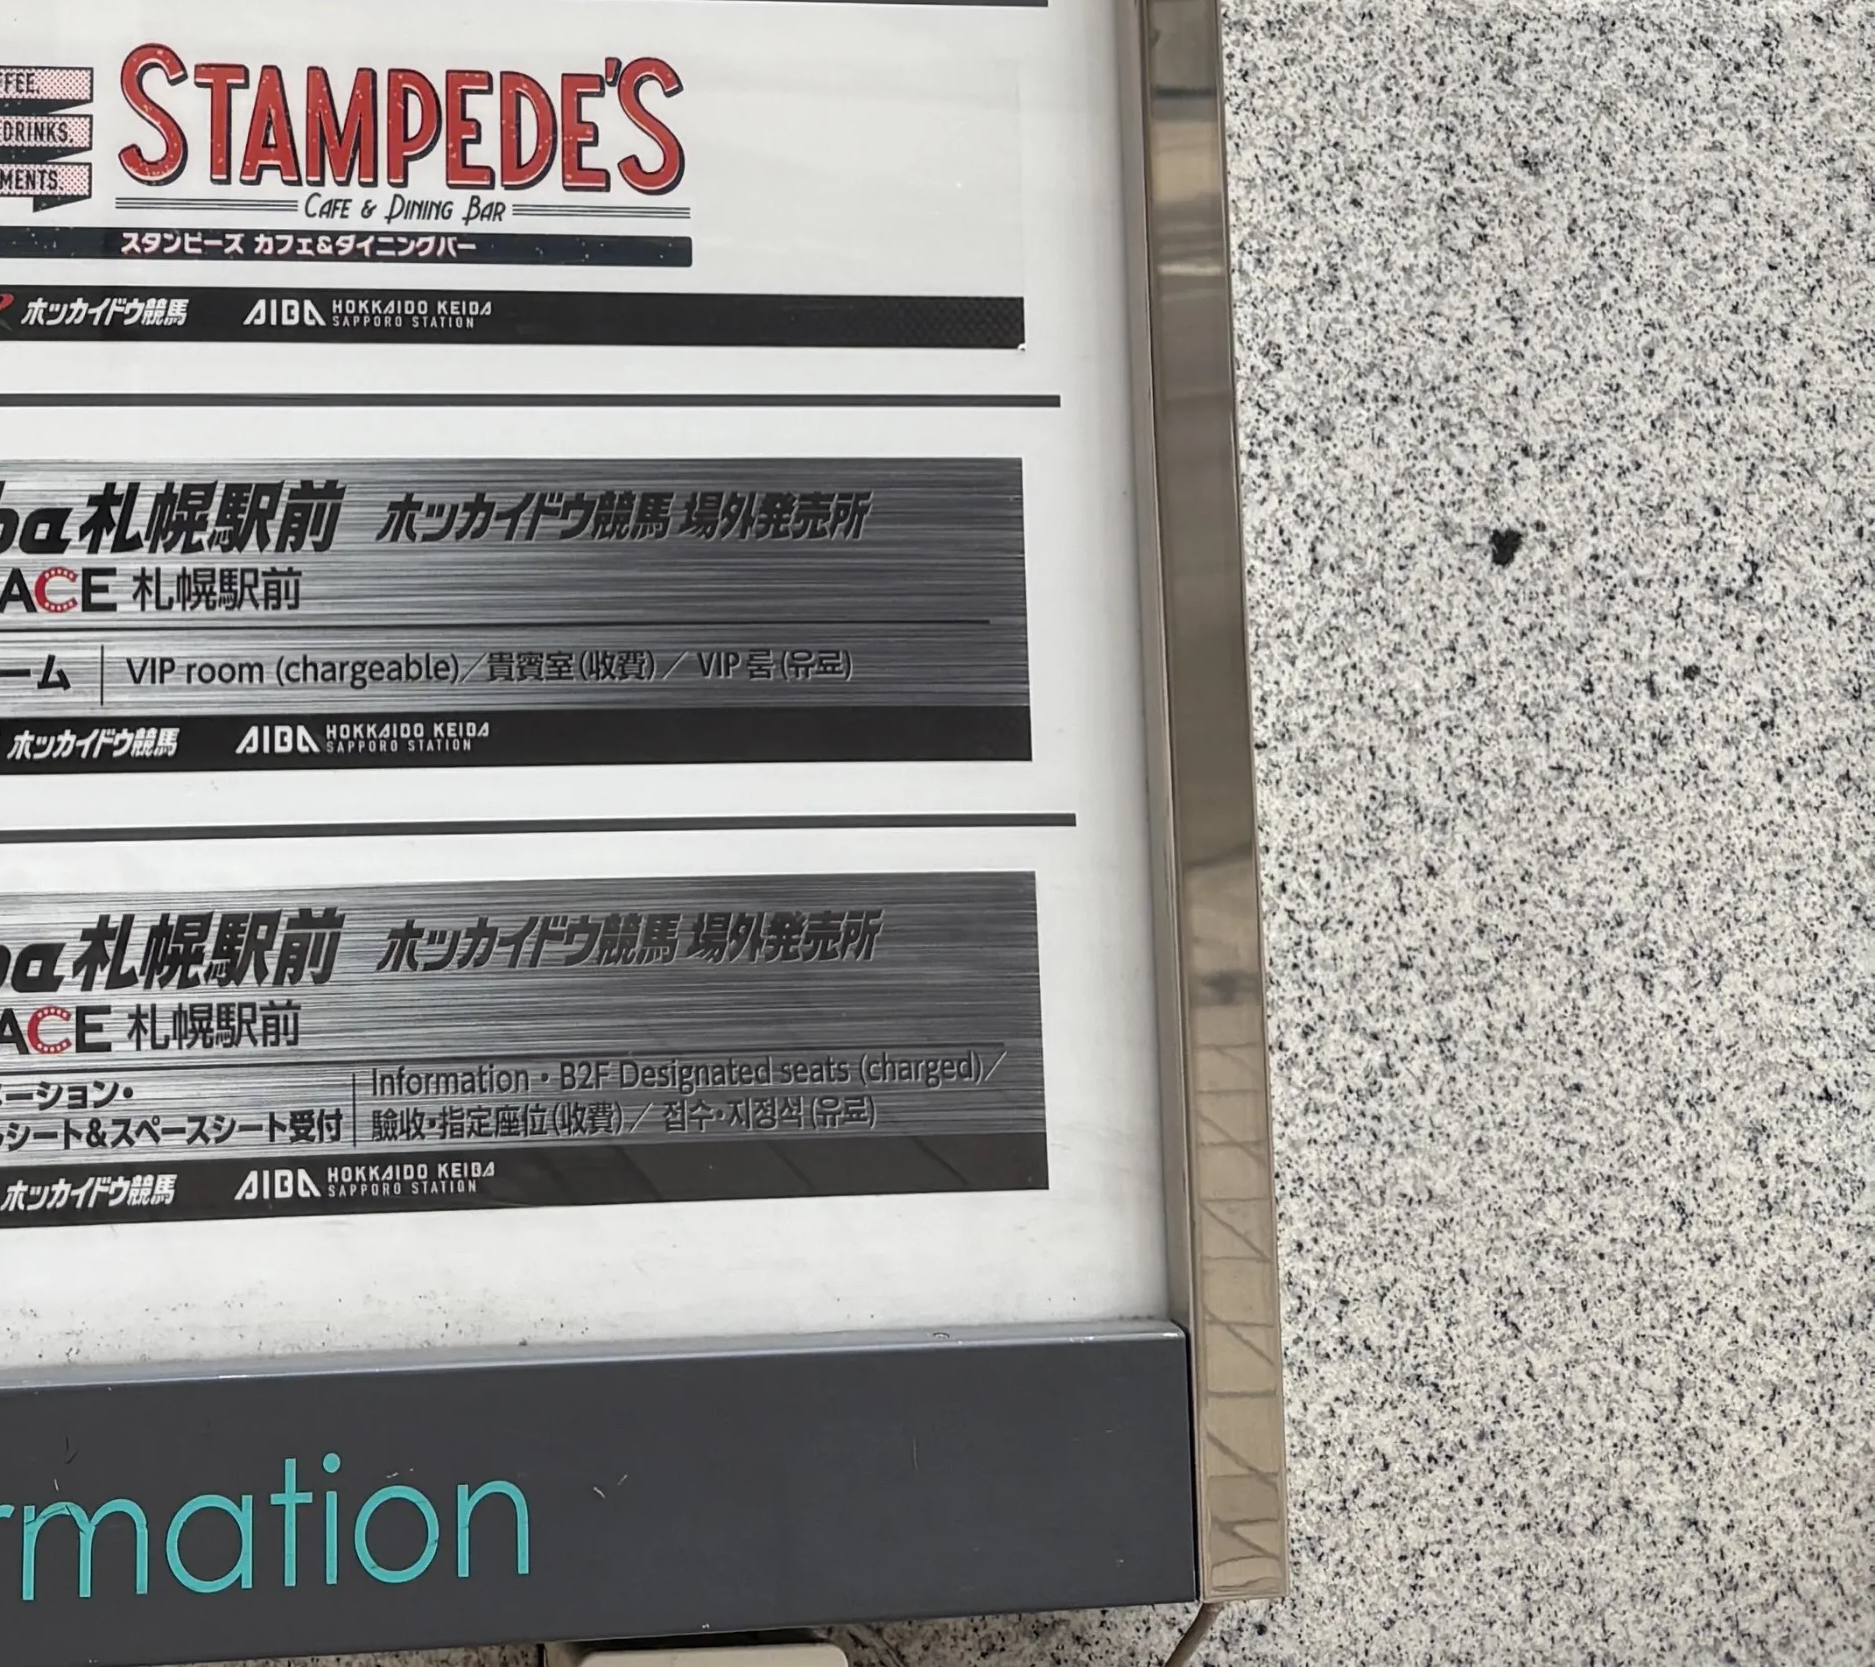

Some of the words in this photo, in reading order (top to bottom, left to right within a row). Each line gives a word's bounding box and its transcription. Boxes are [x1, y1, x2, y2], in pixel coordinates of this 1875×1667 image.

[117, 42, 685, 196] STAMPEDE'S
[360, 198, 378, 219] &
[20, 296, 190, 327] ホッカイドウ競馬
[332, 299, 428, 315] HOKKAIDO
[332, 315, 403, 328] SAPPORO
[412, 316, 475, 329] STATION
[131, 566, 303, 612] 札幌駅前
[125, 656, 176, 685] VIP
[185, 660, 264, 685] room
[697, 651, 741, 680] VIP
[6, 727, 181, 760] ホッカイドウ競馬
[326, 721, 425, 740] HOKKAIDO
[326, 739, 400, 754] SAPPORO
[407, 738, 472, 752] STATION
[126, 999, 302, 1052] 札幌駅前
[618, 1055, 774, 1097] Designated
[779, 1061, 851, 1087] seats
[327, 1162, 429, 1183] HOKKAIDO
[0, 1173, 178, 1213] ホッカイドウ競馬
[327, 1181, 403, 1199] SAPPORO
[410, 1179, 478, 1196] STATION
